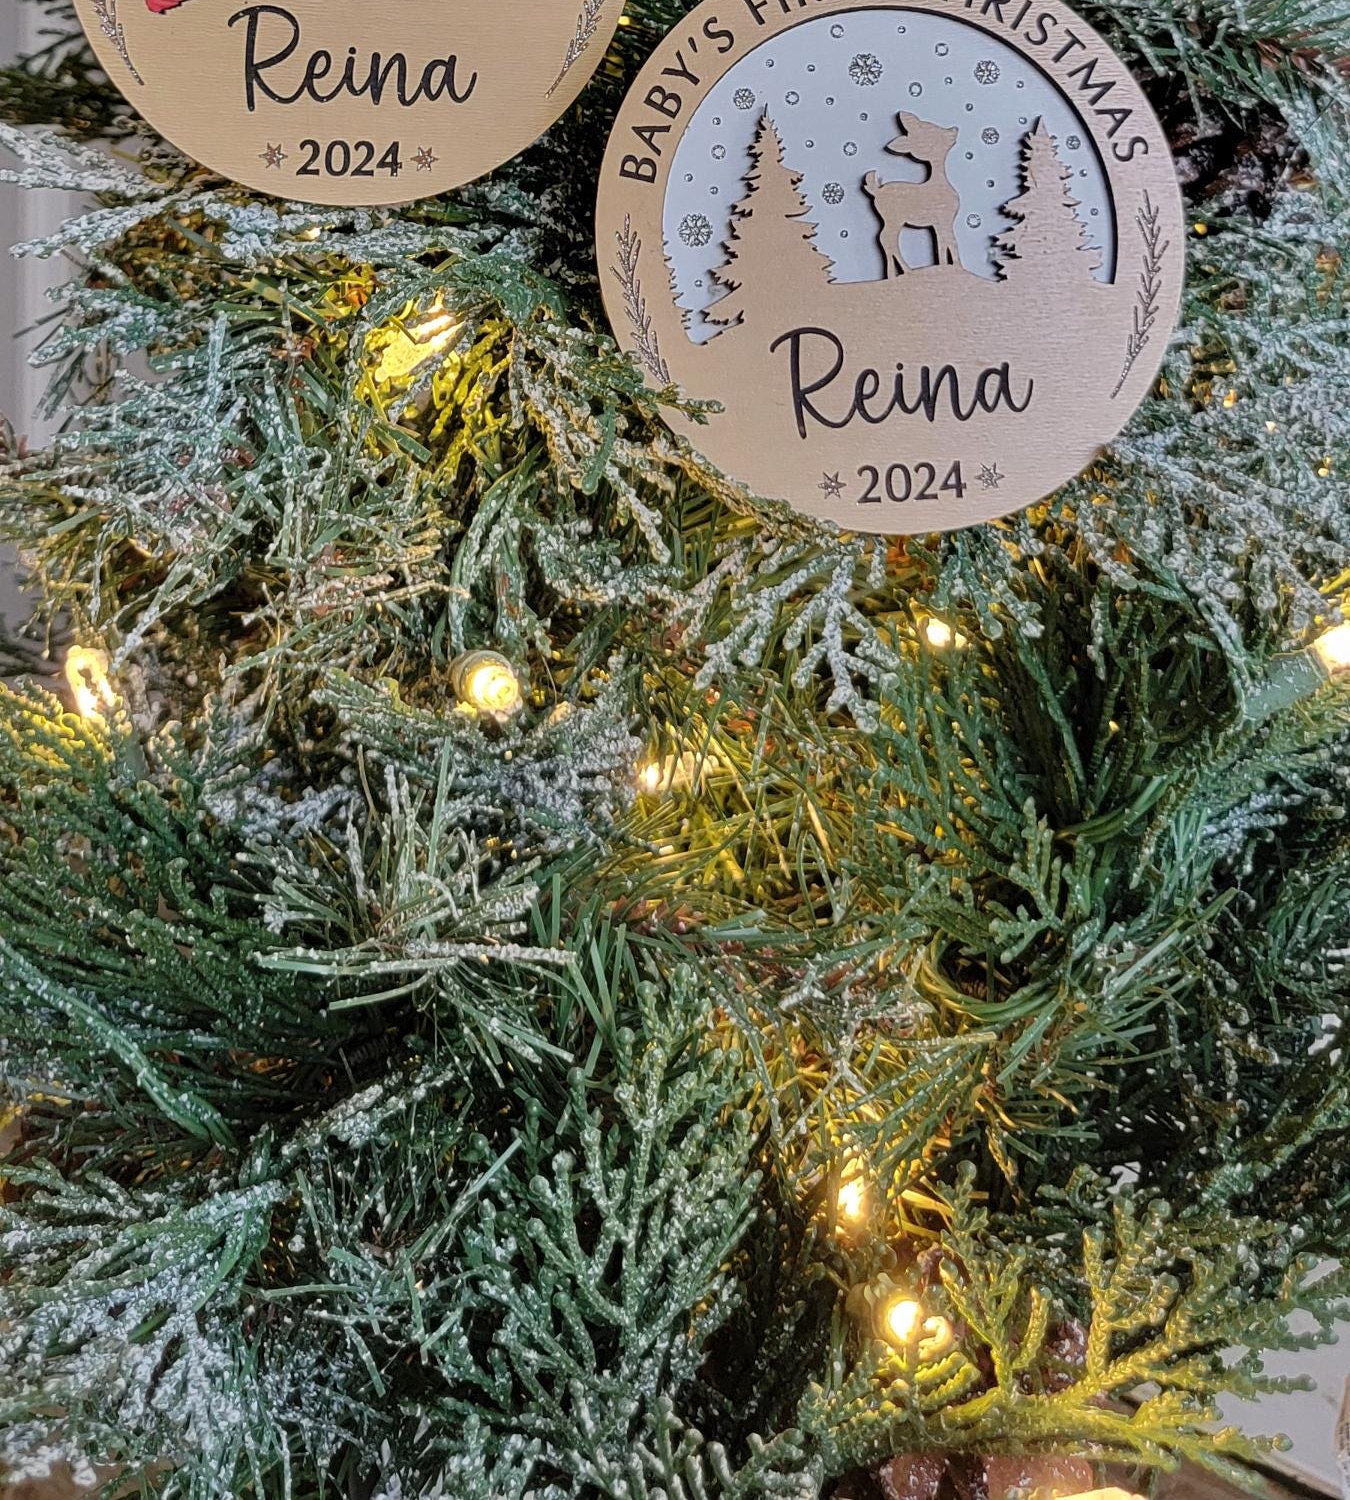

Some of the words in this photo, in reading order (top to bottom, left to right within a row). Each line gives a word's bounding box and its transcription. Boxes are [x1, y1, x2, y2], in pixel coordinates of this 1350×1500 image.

[227, 4, 478, 112] Reina
[618, 16, 735, 185] BABY'S
[295, 139, 403, 177] 2024
[769, 326, 1034, 439] Reina
[856, 460, 967, 504] 2024
